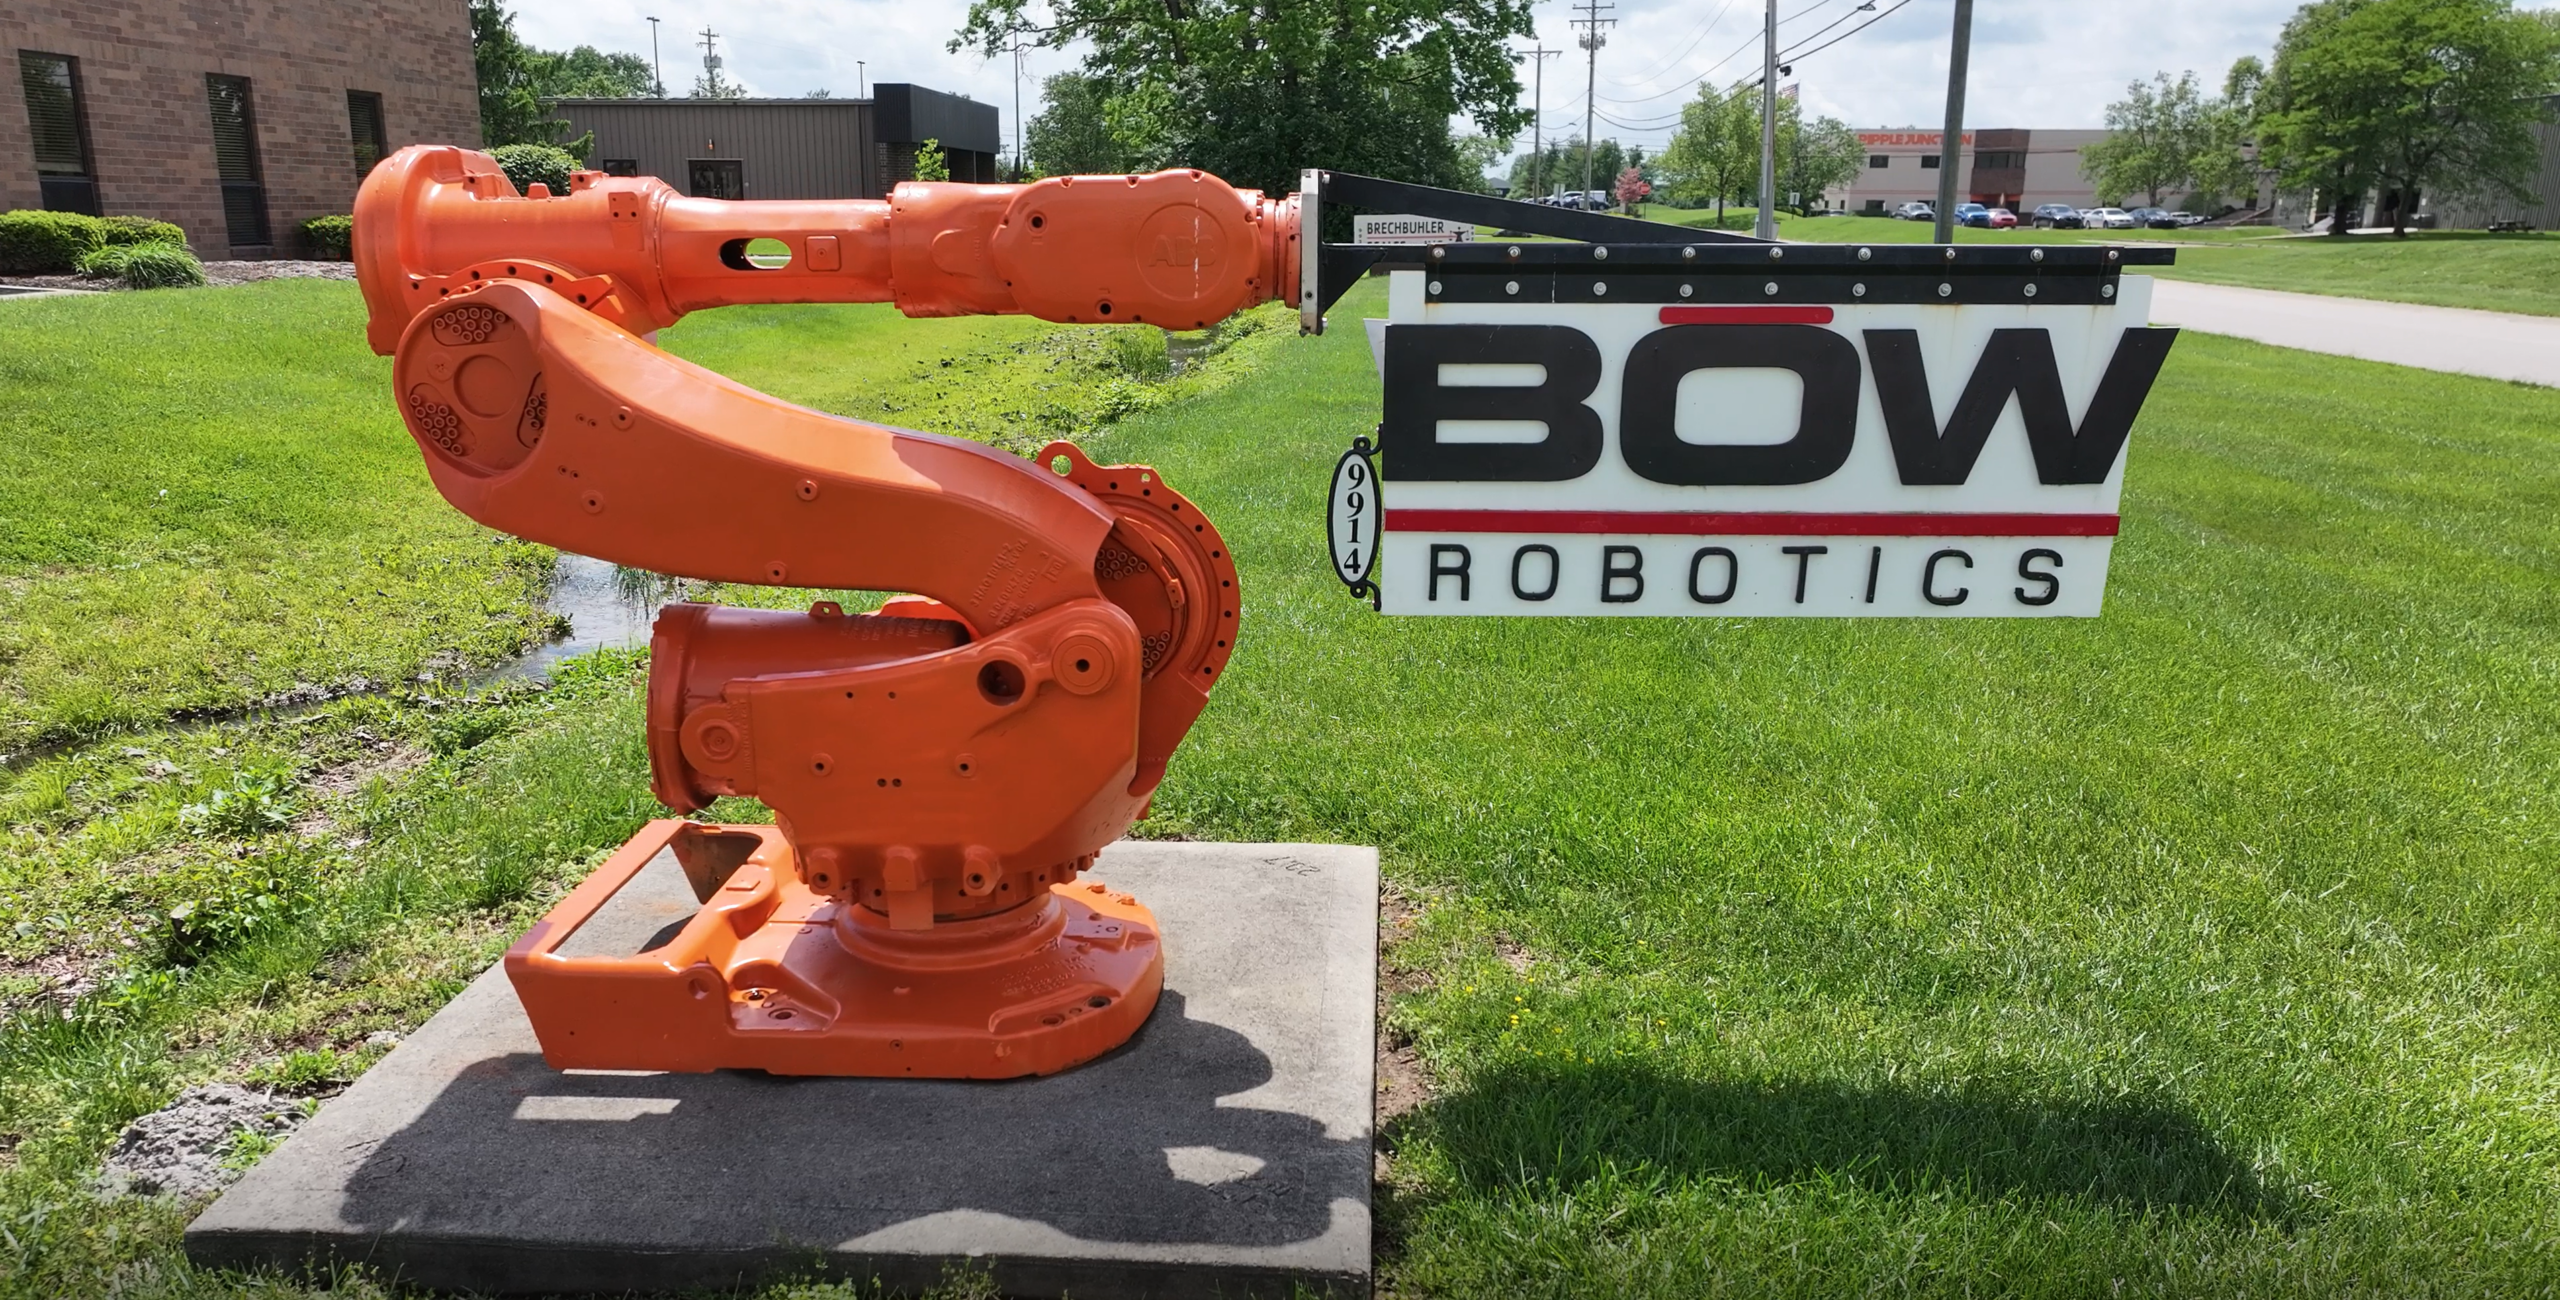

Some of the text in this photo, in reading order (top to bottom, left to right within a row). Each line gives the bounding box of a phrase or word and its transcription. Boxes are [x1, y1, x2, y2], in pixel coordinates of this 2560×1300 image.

[1149, 234, 1217, 267] ABB
[1367, 222, 1444, 234] BRECHBUHLER
[1343, 463, 1366, 575] 9914
[1429, 543, 2064, 607] ROBOTICS
